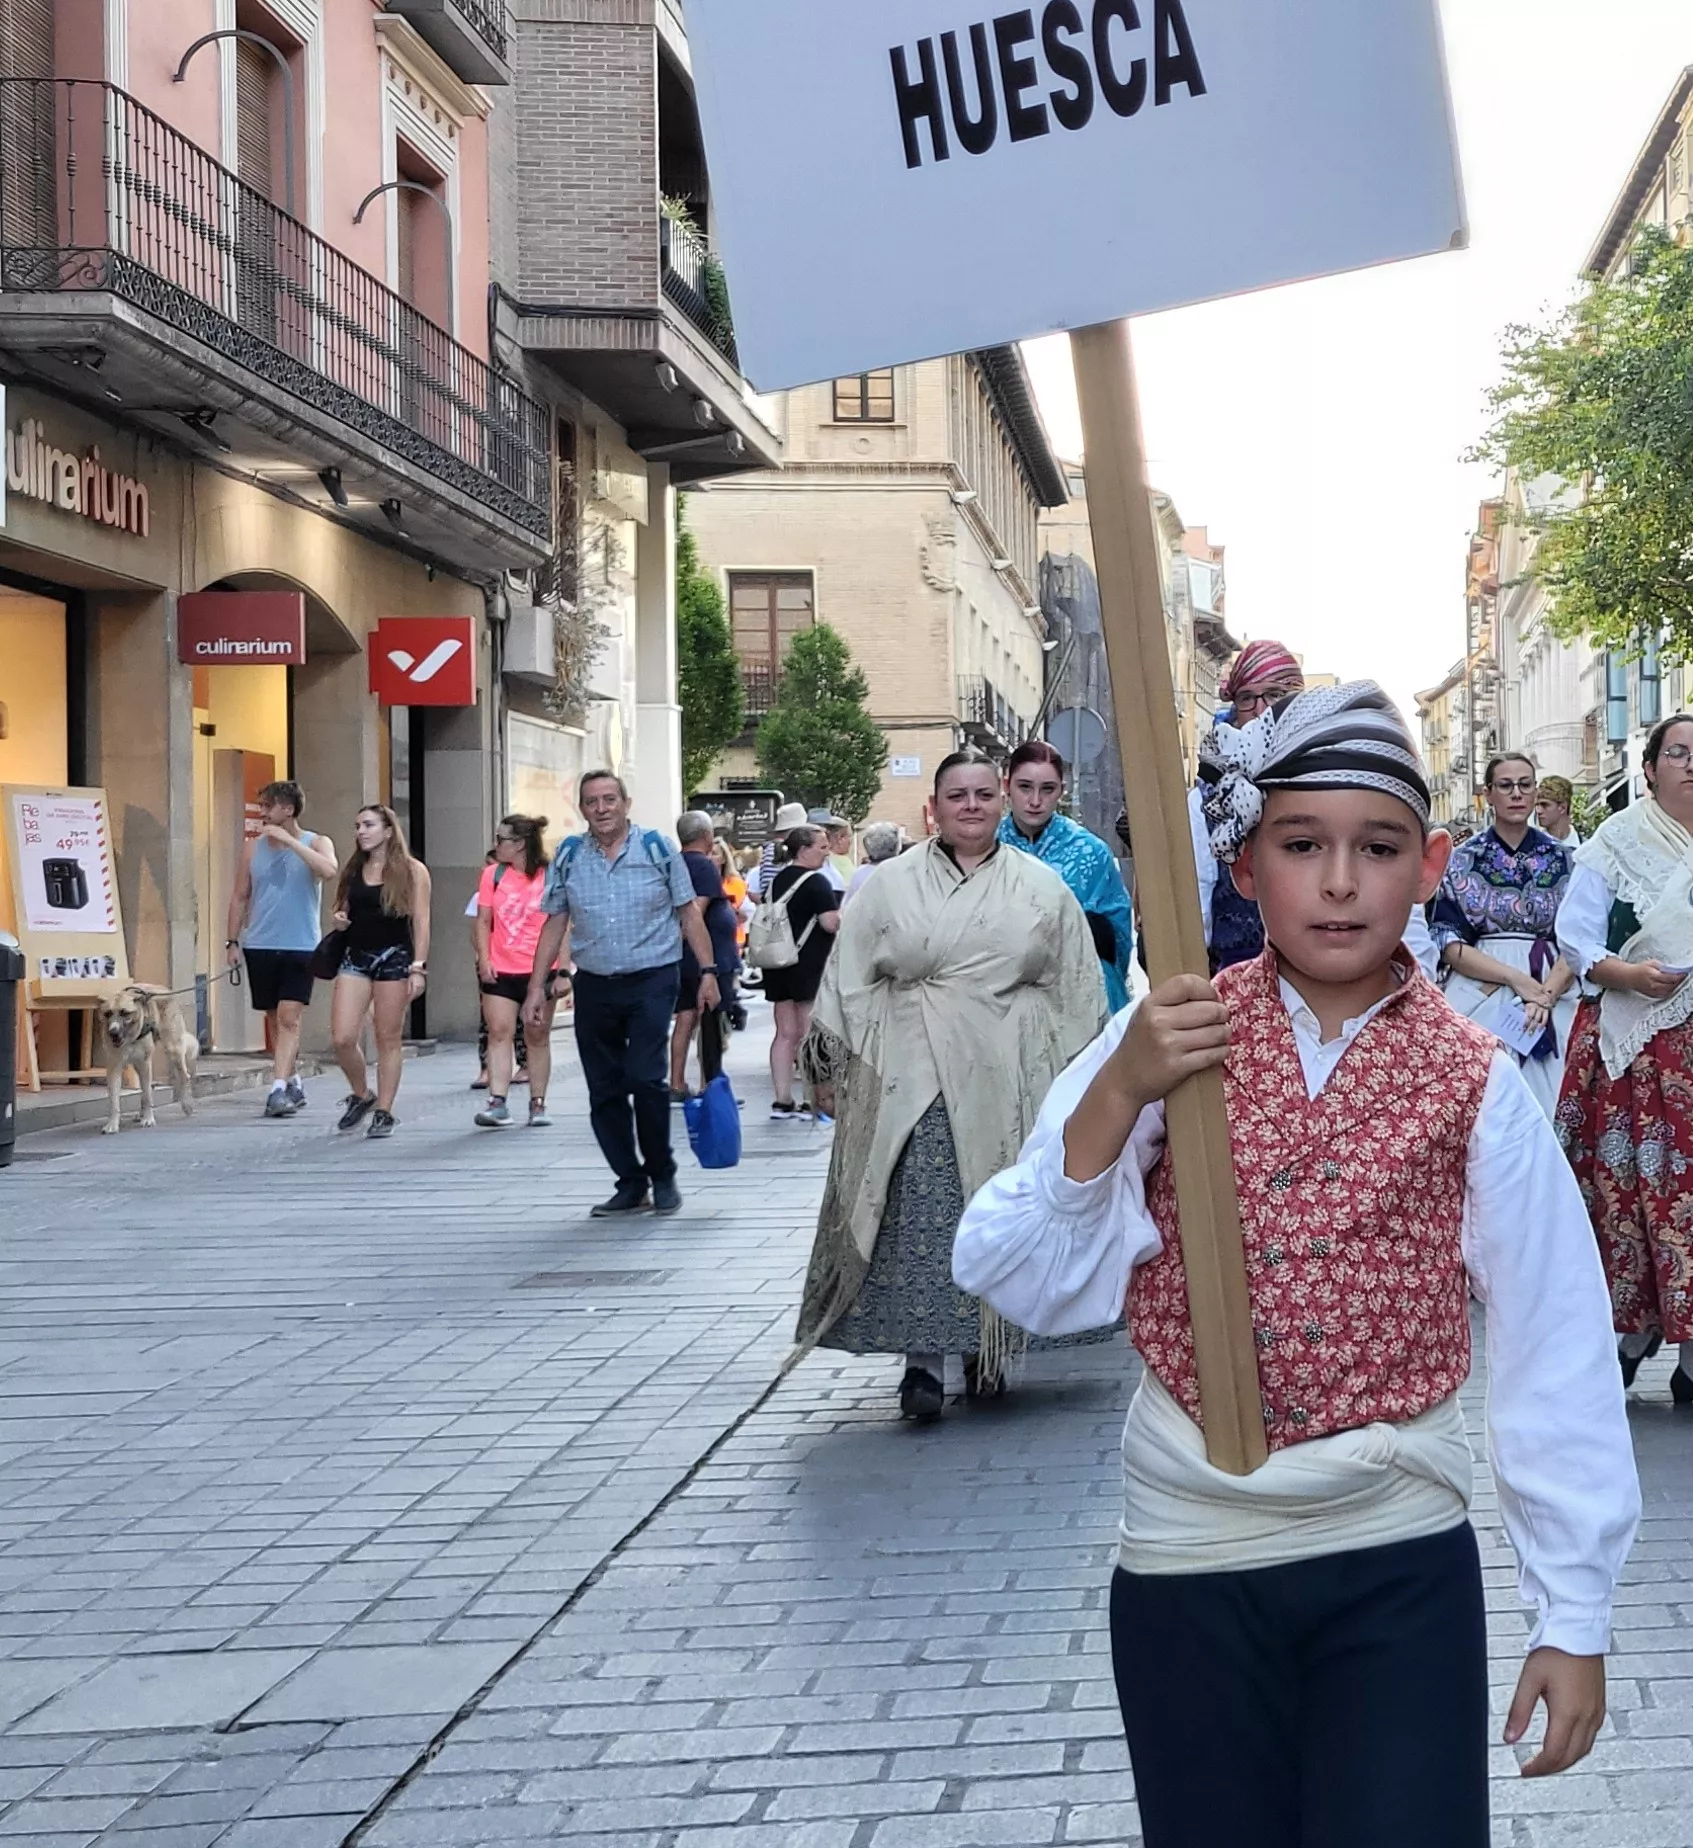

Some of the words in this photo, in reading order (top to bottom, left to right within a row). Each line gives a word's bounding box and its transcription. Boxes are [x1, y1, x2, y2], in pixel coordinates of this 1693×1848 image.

[889, 0, 1207, 169] HUESCA
[7, 418, 149, 537] ulinarium
[195, 637, 292, 655] culinarium
